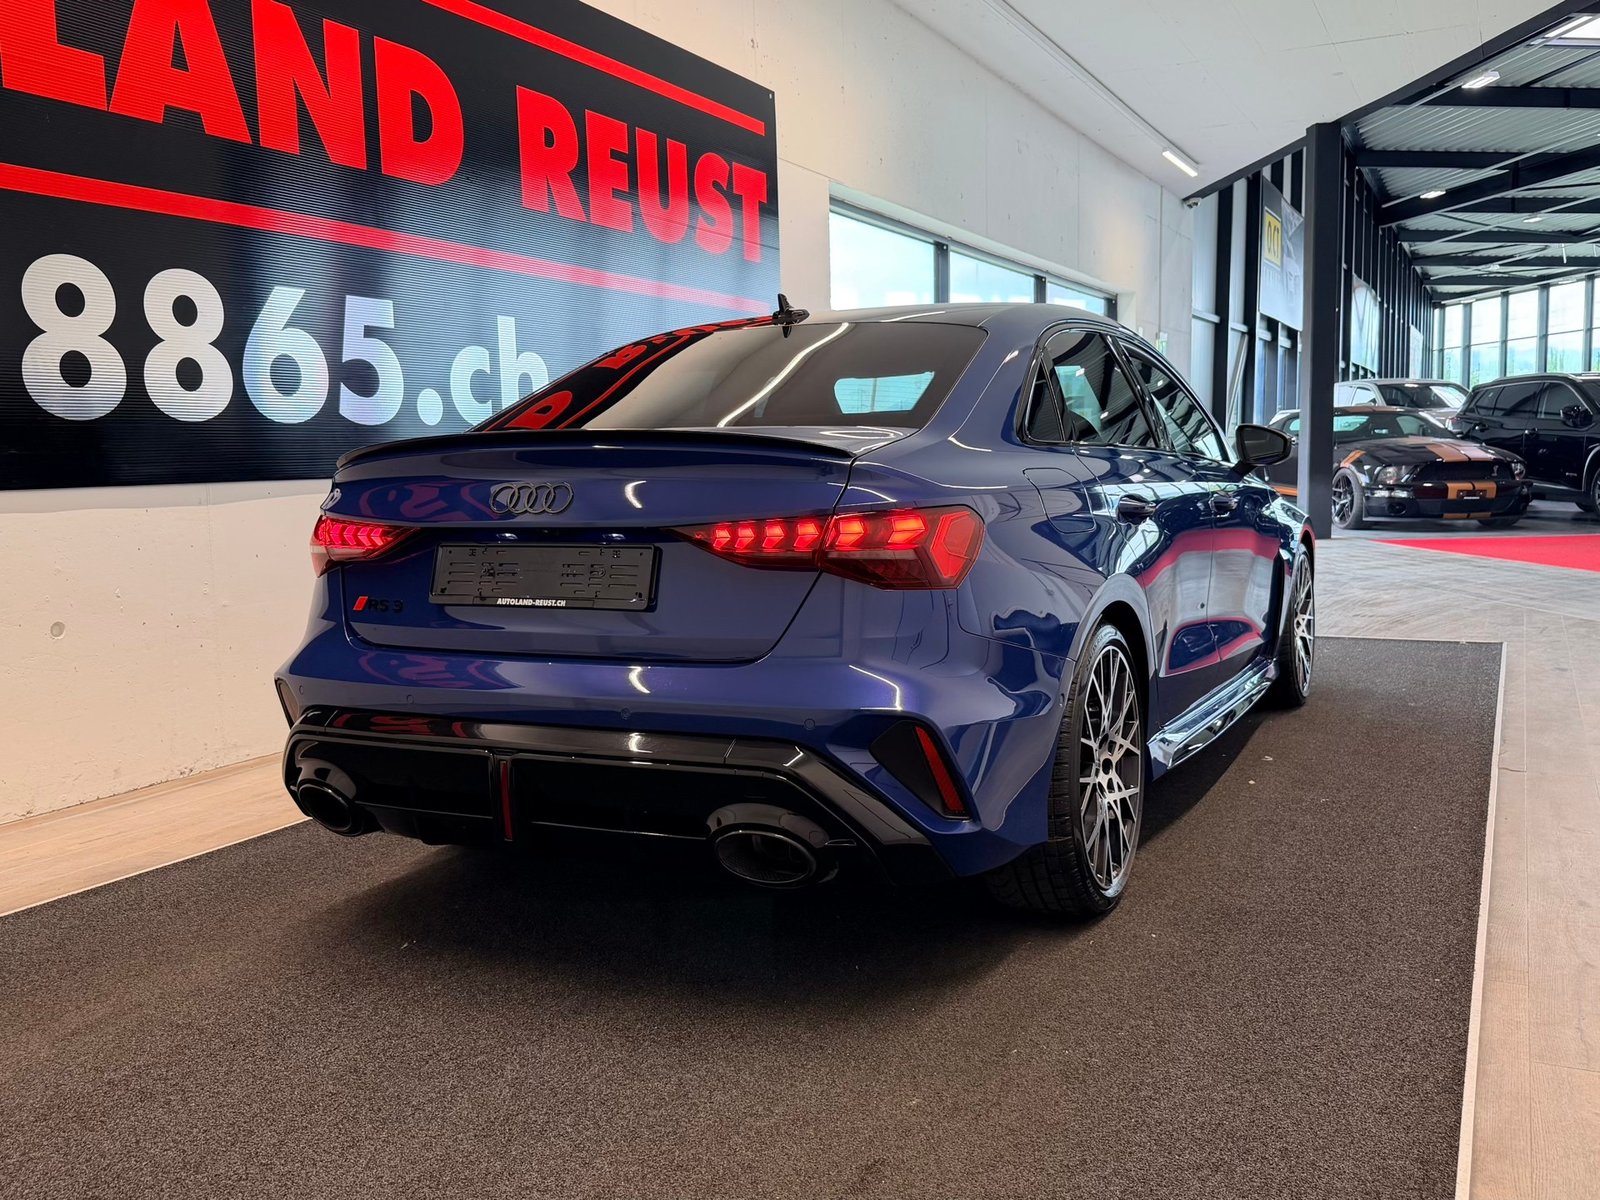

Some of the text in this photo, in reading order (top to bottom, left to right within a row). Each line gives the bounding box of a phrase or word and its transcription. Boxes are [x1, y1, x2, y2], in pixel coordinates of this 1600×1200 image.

[516, 85, 767, 263] REUST
[21, 253, 550, 425] 8865.ch
[367, 598, 389, 612] RS
[496, 597, 567, 607] AUTOLAND-REUST.CH
